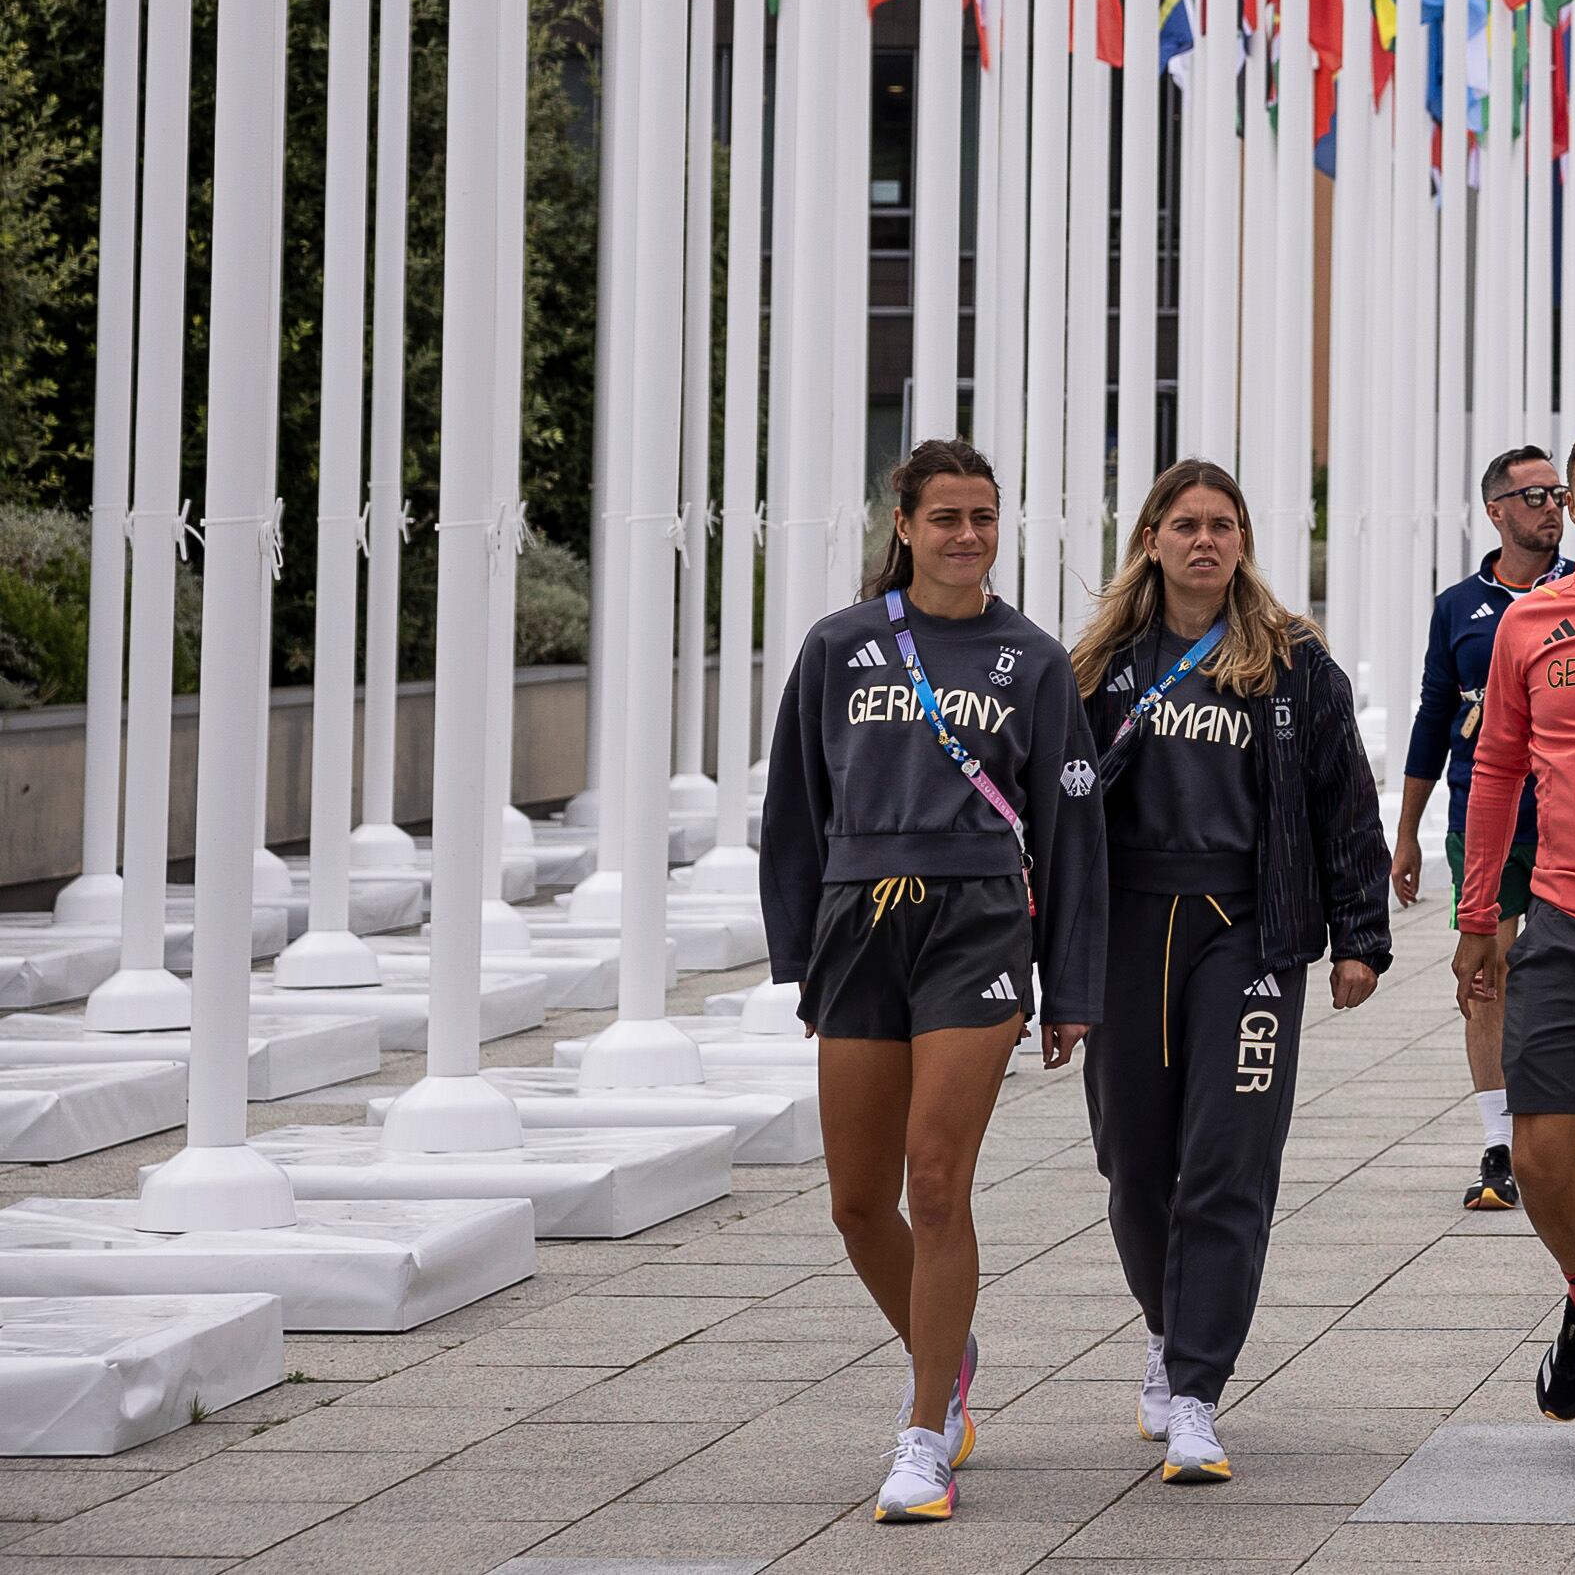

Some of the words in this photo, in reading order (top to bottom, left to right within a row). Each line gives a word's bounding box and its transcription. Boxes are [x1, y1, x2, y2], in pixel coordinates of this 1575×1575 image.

[847, 685, 1017, 735] GERMANY
[1150, 700, 1253, 750] RMANY
[1235, 1011, 1279, 1092] GER
